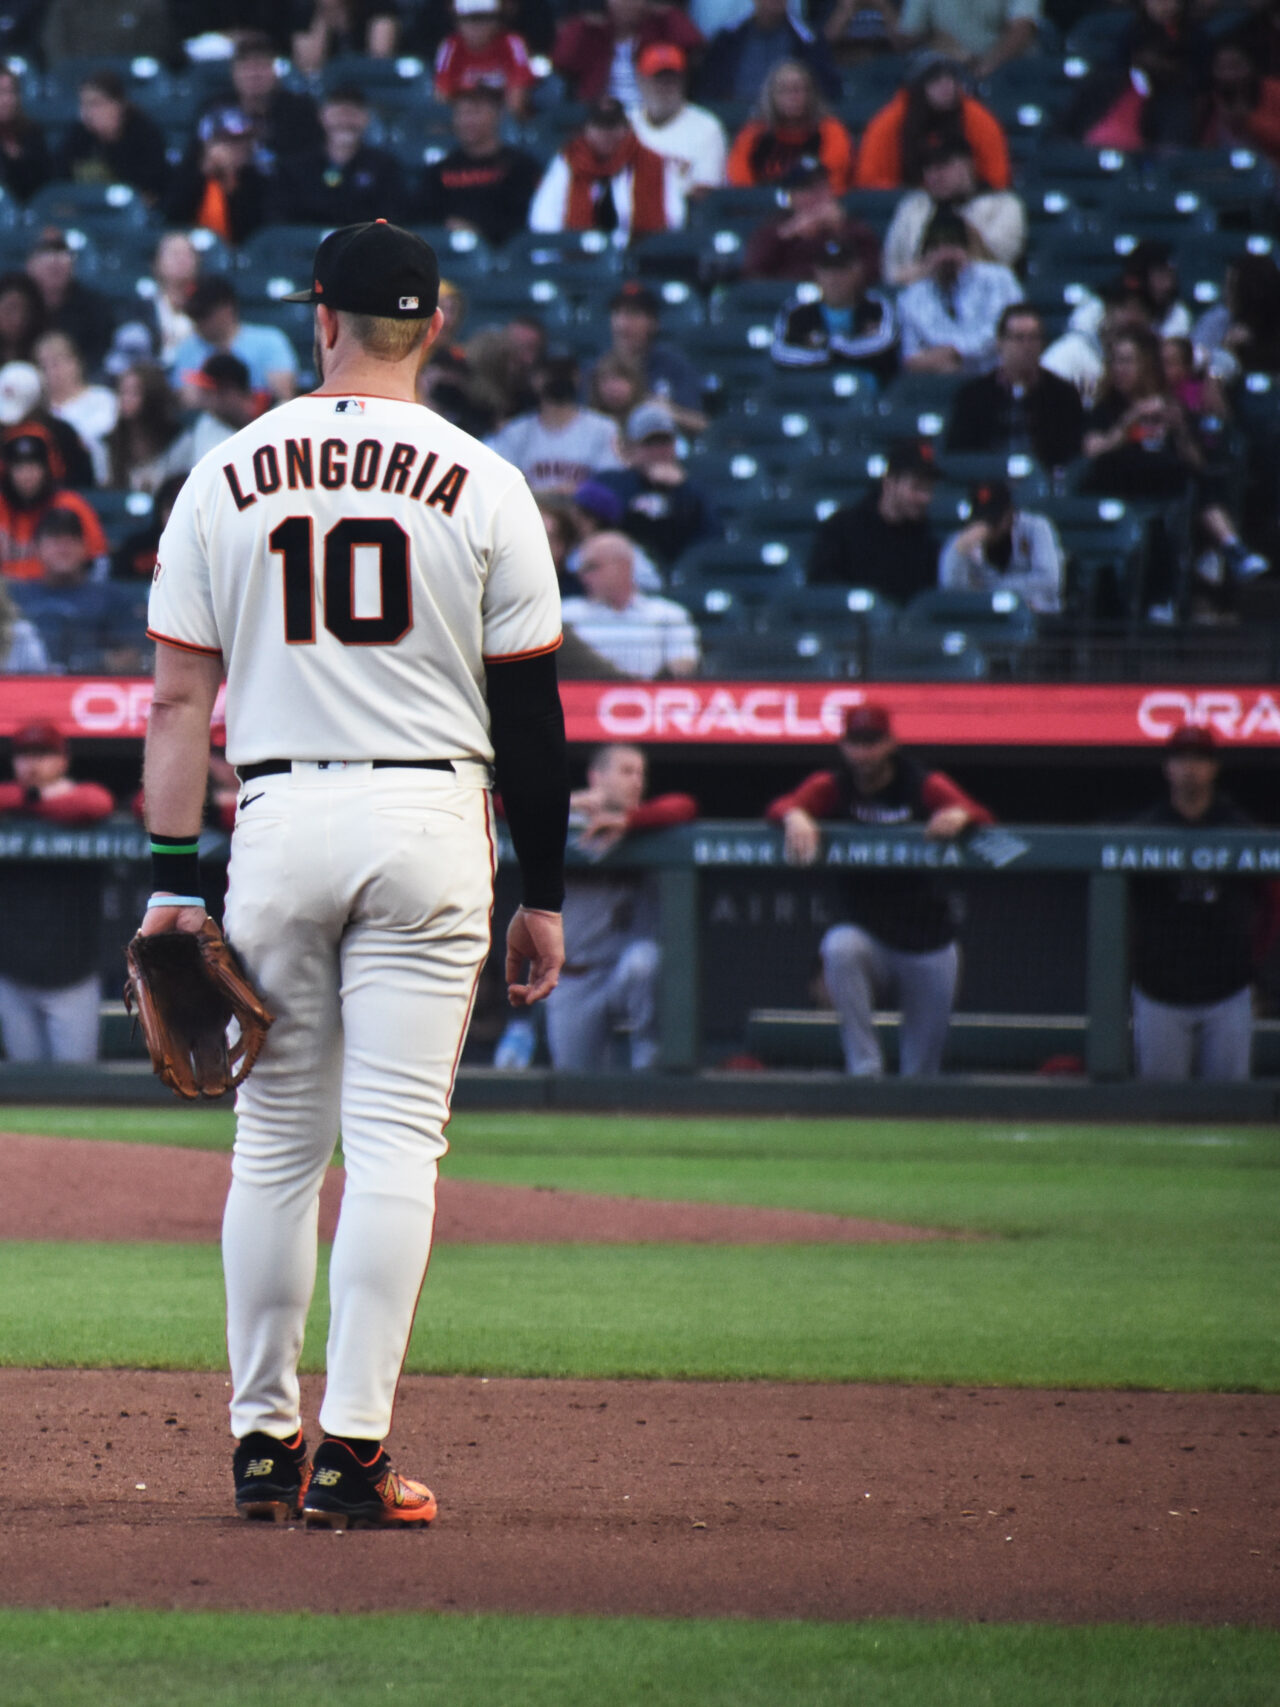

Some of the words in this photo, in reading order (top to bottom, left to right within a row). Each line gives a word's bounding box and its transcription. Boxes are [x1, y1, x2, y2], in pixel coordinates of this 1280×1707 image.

[223, 438, 469, 517] LONGORIA
[269, 516, 414, 646] 10
[597, 688, 867, 736] ORACLE
[693, 839, 776, 866] BANK
[827, 841, 962, 867] AMERICA
[1102, 844, 1184, 870] BANK
[1191, 848, 1230, 871] OF
